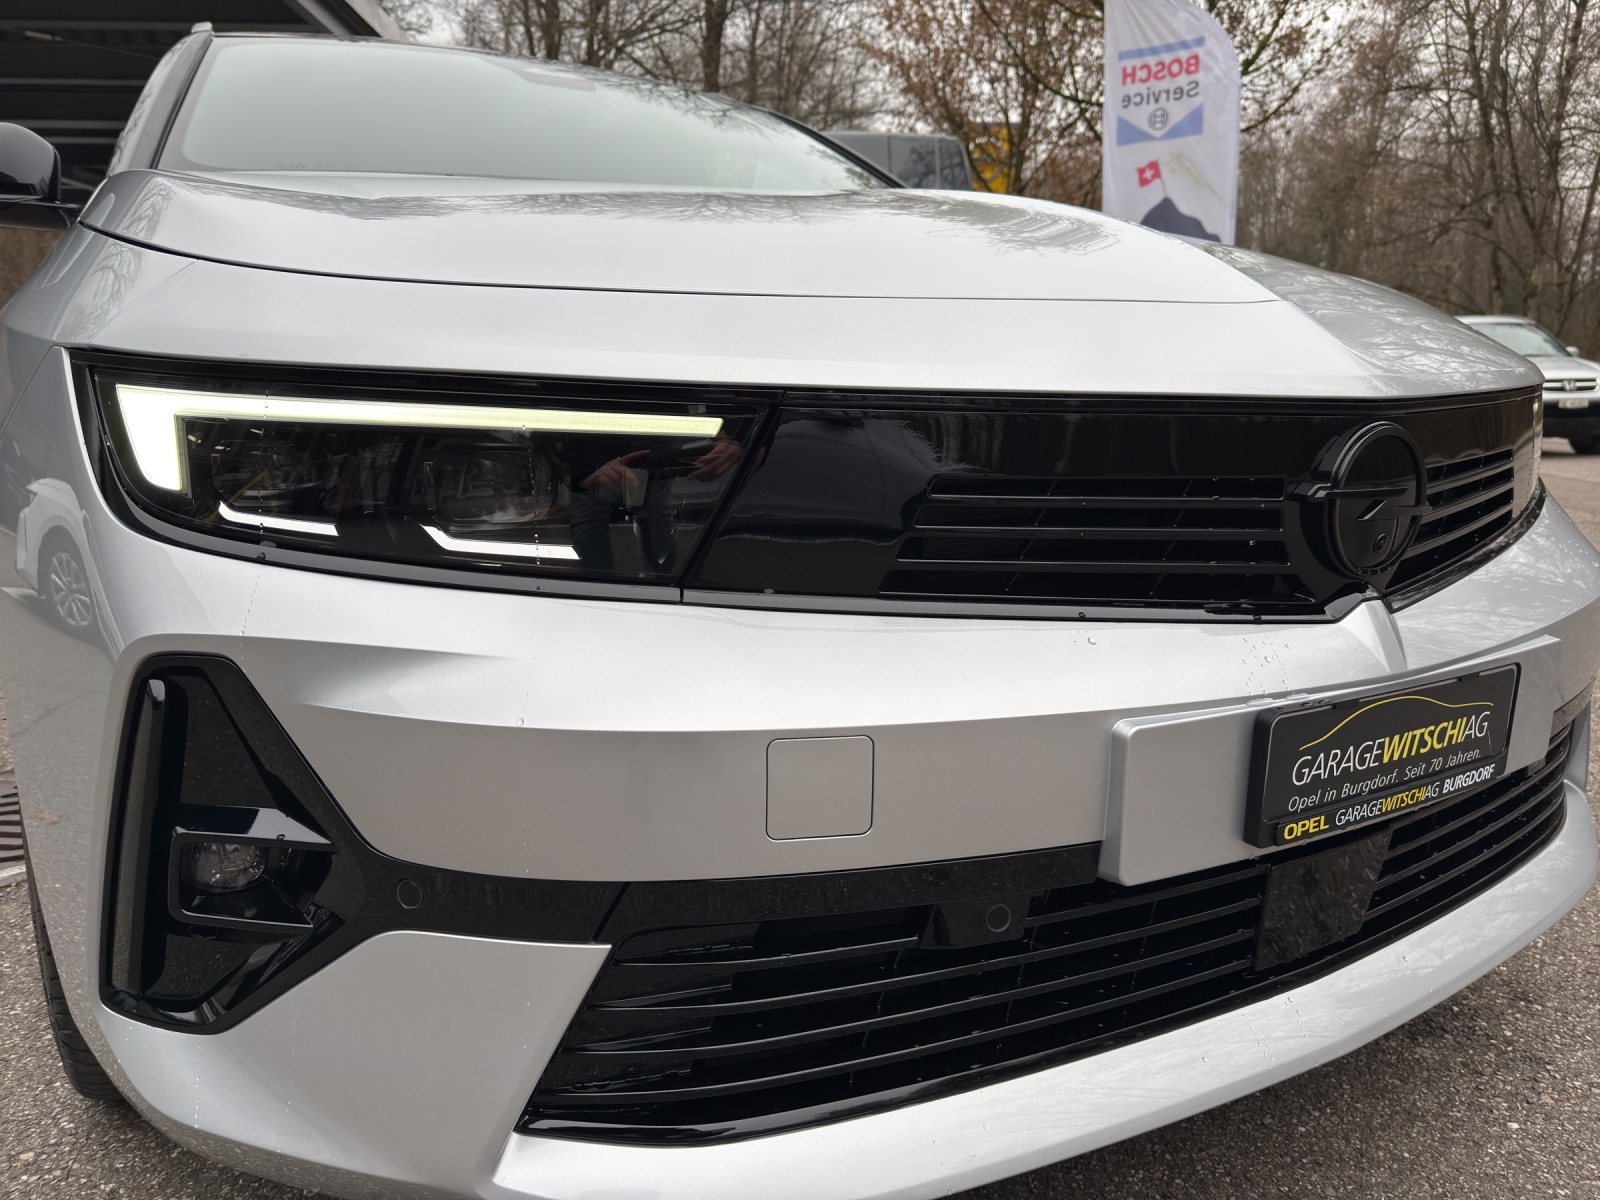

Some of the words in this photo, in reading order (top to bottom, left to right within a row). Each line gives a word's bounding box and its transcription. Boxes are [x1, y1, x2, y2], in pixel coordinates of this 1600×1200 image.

[1283, 815, 1330, 840] OPEL
[1442, 764, 1496, 794] BURGDORF
[1288, 789, 1321, 813] Opel
[1324, 788, 1337, 803] in
[1341, 768, 1399, 796] Burgdorf.
[1403, 762, 1427, 780] Seit
[1429, 757, 1443, 773] 70
[1445, 749, 1482, 769] Jahren.
